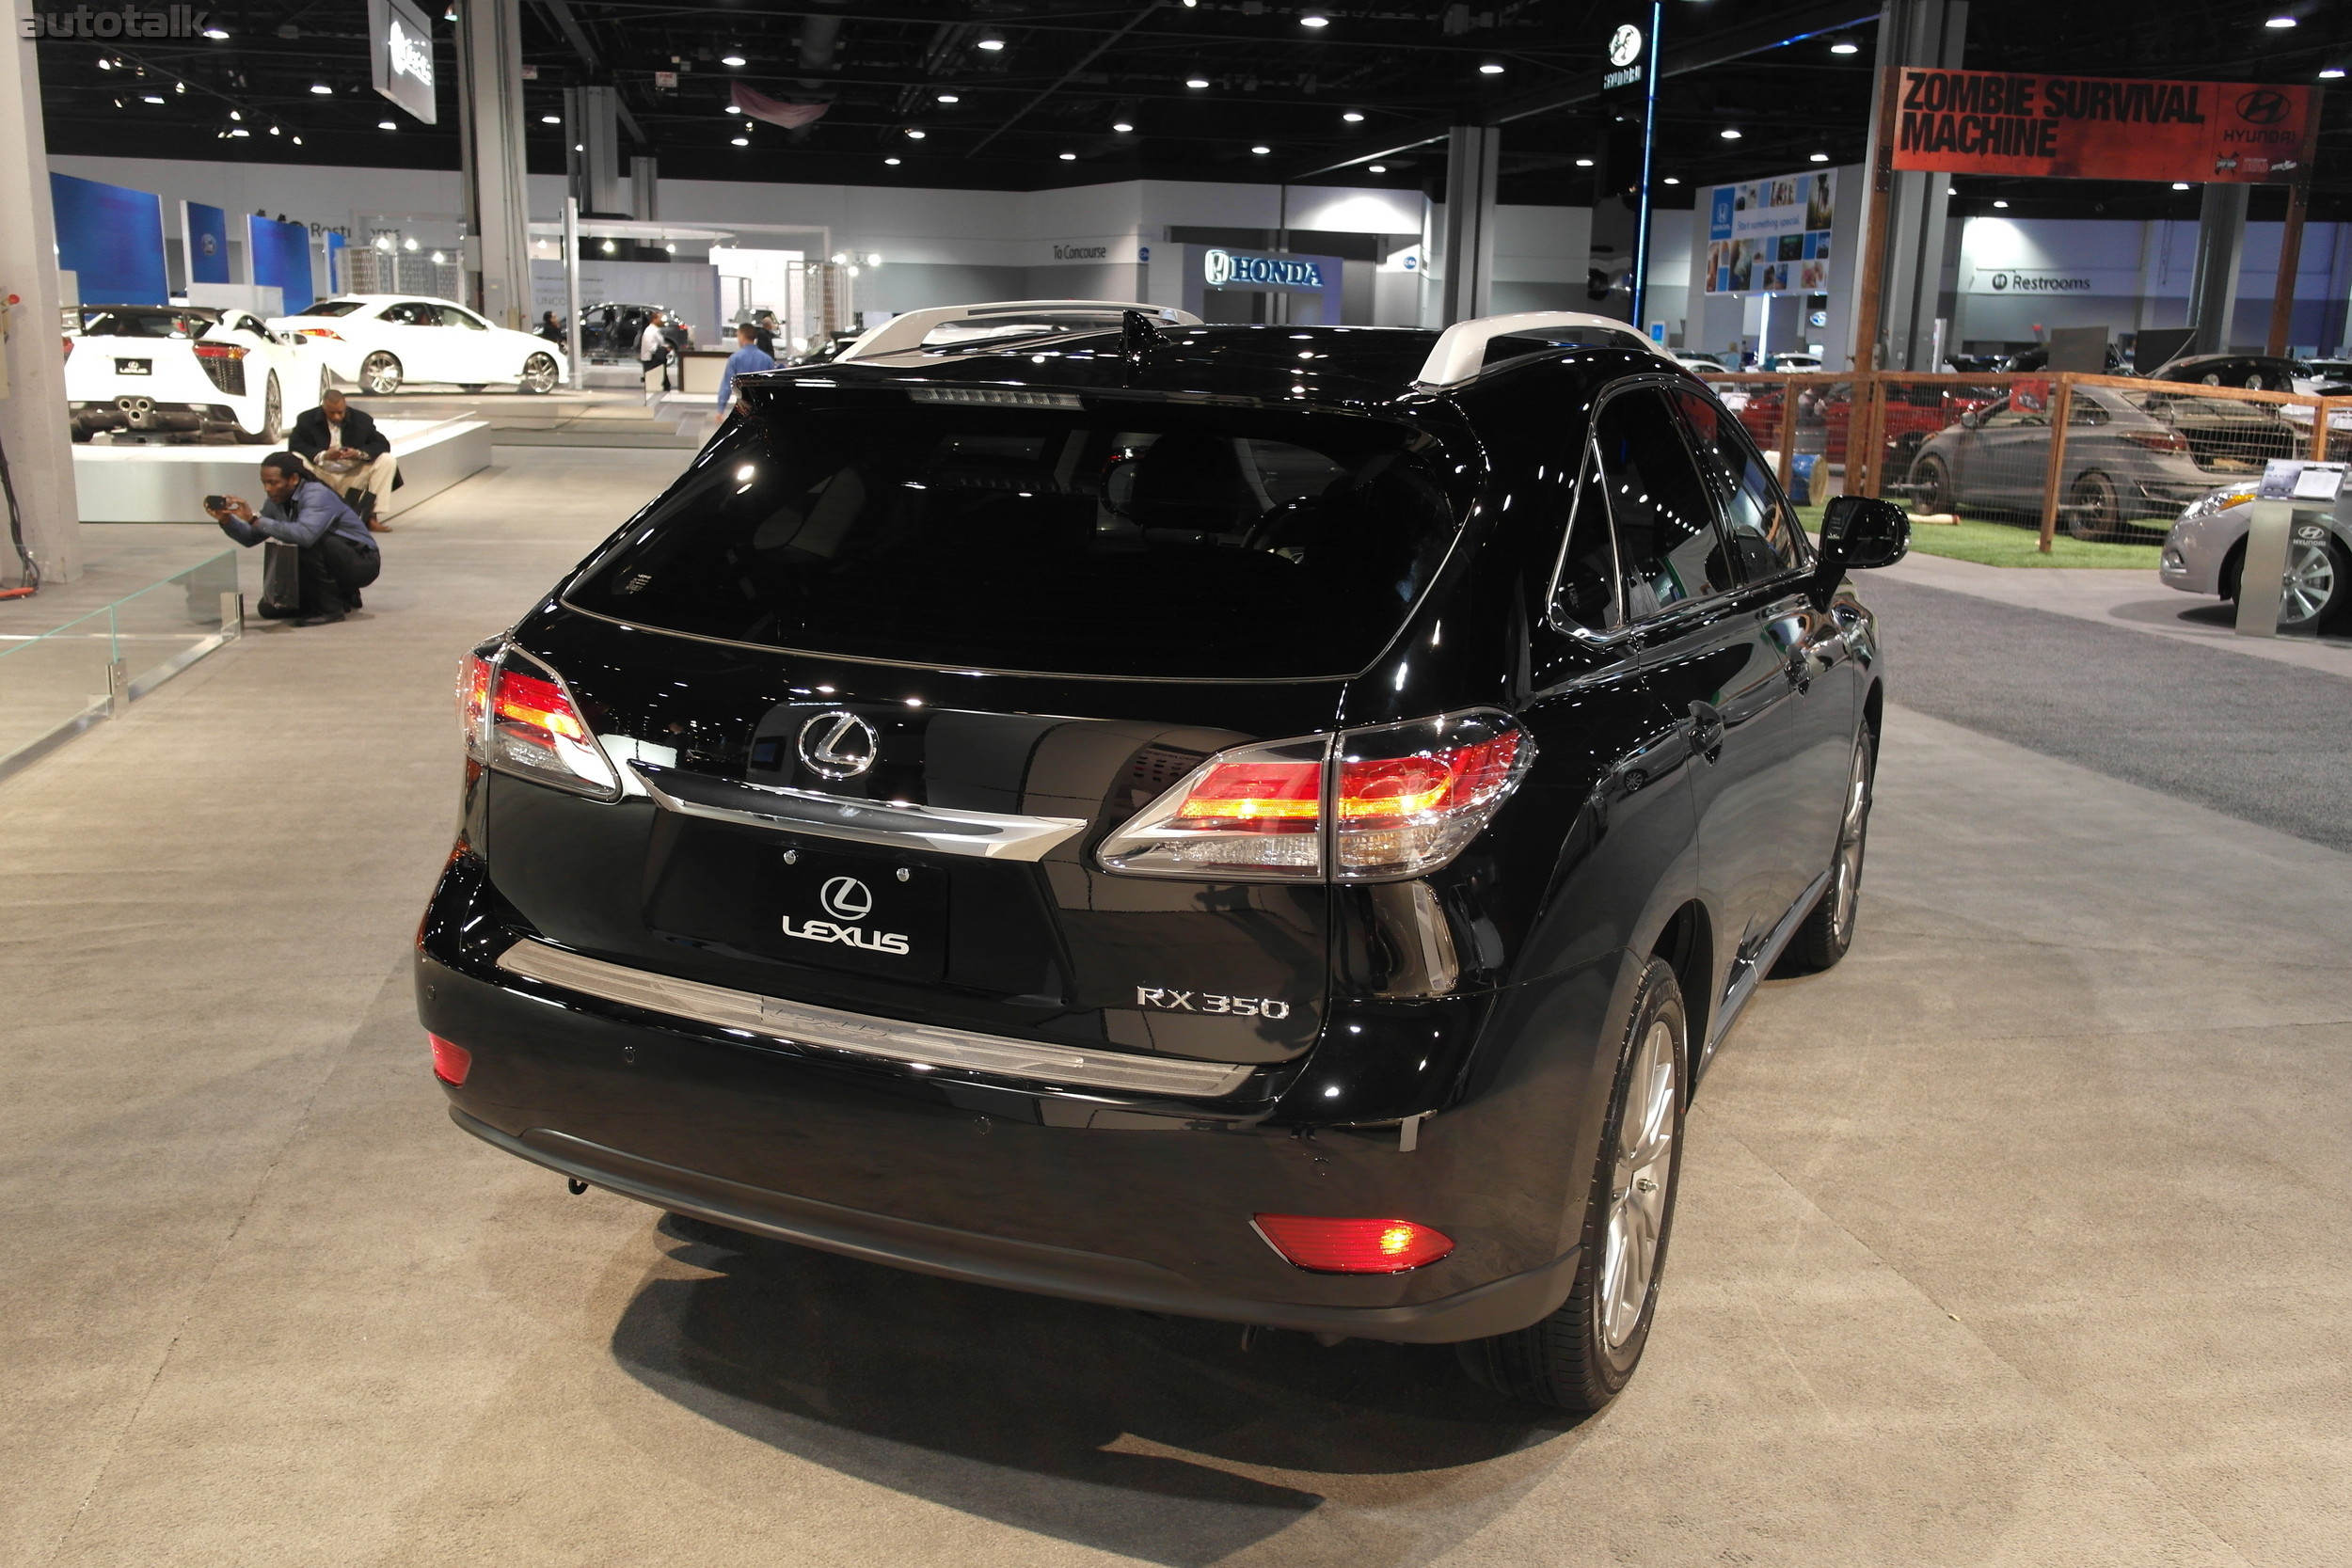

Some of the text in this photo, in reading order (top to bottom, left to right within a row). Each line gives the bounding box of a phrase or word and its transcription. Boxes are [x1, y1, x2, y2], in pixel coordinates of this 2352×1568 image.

[1902, 72, 2205, 124] ZOMBIE SURVIVAL
[1899, 112, 2059, 158] MACHINE
[2223, 129, 2296, 144] HYUNDAI
[1053, 245, 1106, 260] To Concourse
[1230, 256, 1324, 287] HONDA
[2012, 275, 2090, 291] Restrooms
[2293, 538, 2327, 546] HYUNDAI
[783, 915, 910, 956] LEXUS
[1136, 986, 1290, 1020] RX 350
